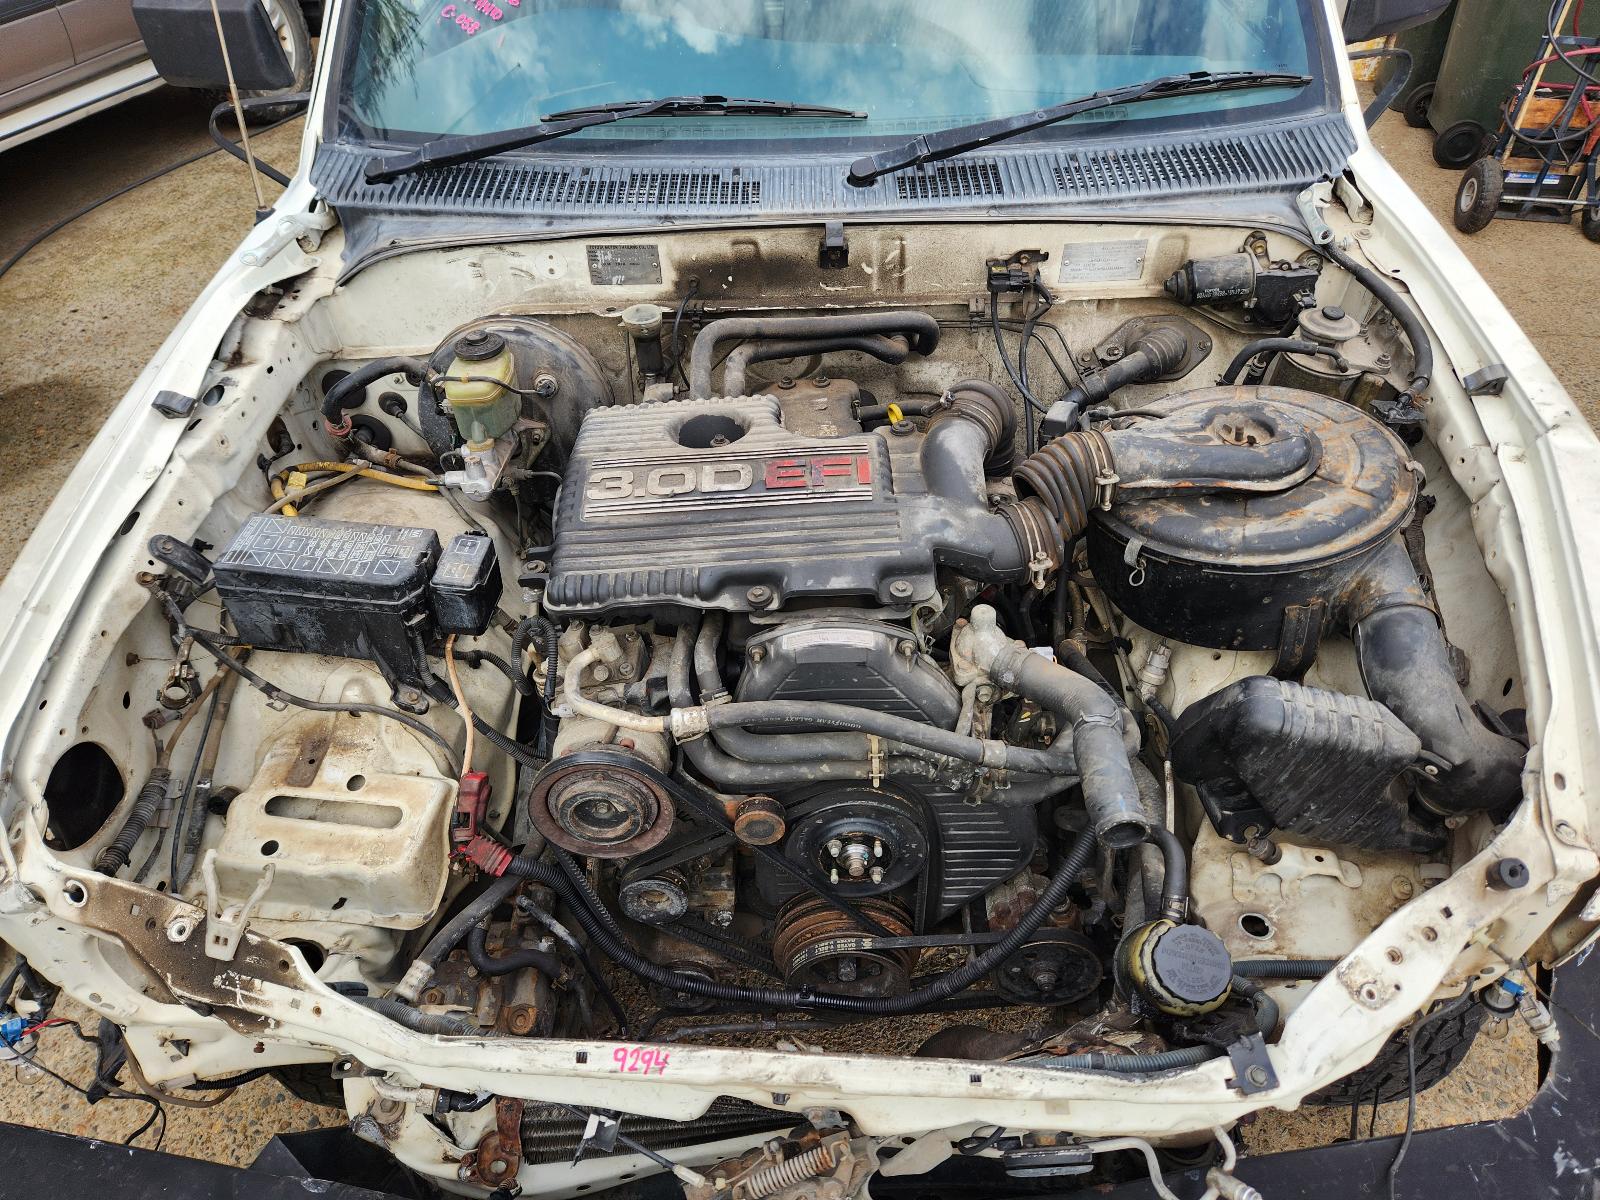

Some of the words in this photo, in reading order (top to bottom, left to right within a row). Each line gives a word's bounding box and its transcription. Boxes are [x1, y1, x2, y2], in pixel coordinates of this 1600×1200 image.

[586, 463, 753, 500] 3.0D
[764, 455, 872, 489] EFI
[613, 1047, 671, 1075] 9294
